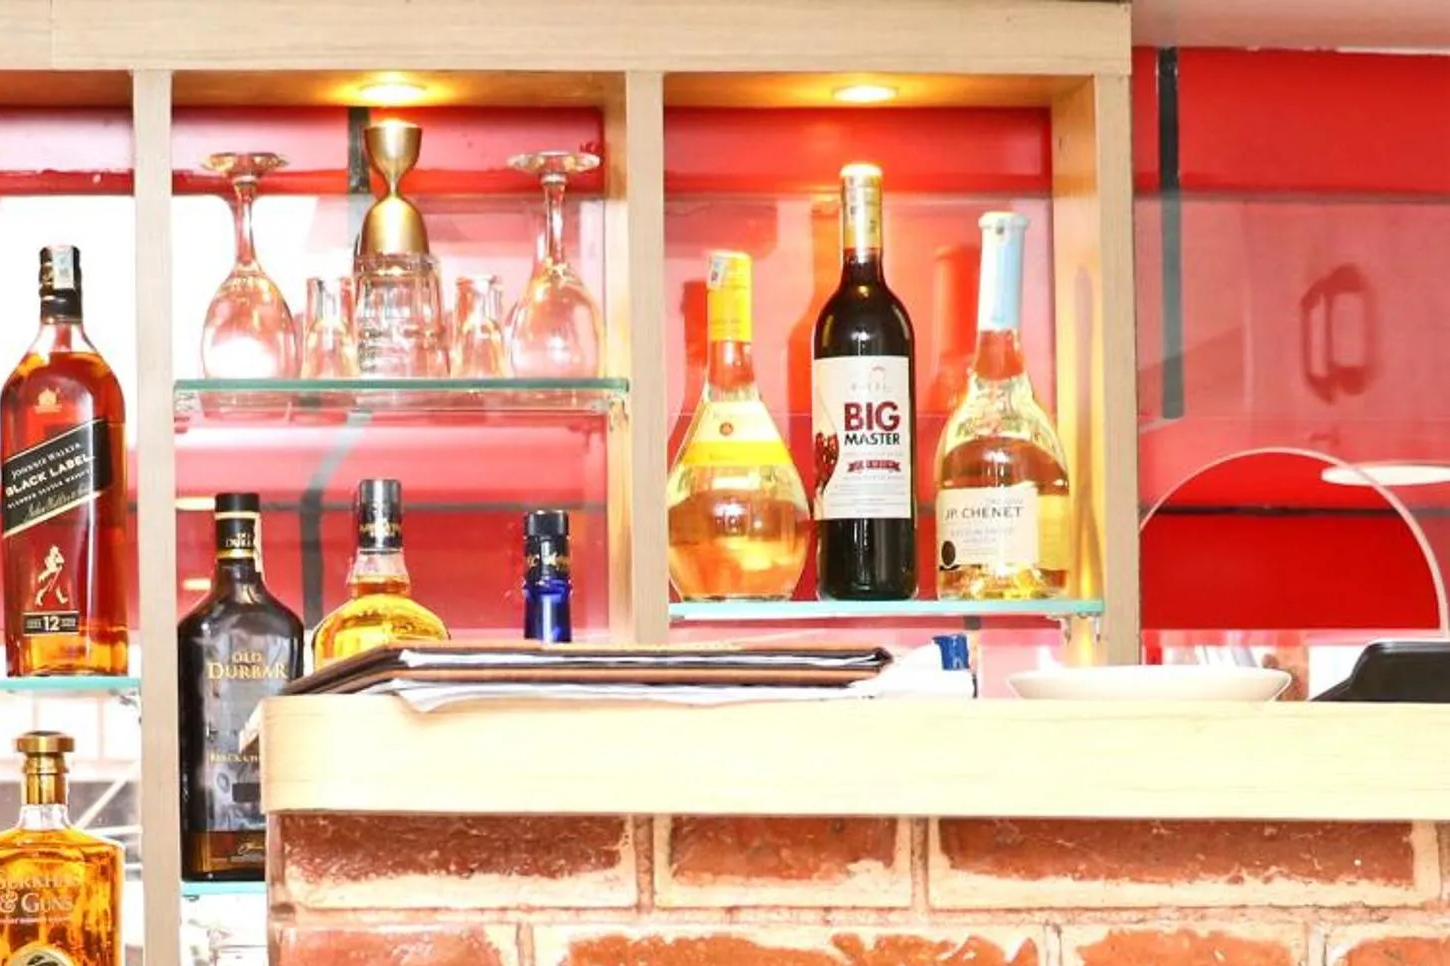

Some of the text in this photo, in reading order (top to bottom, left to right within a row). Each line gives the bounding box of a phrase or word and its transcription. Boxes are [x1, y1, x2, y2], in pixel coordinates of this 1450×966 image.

[844, 401, 900, 432] BIG
[844, 432, 900, 445] MASTER
[6, 453, 95, 497] BLACK LABEL
[962, 506, 1024, 519] CHENET
[43, 615, 60, 631] 12
[232, 651, 263, 662] OLD
[206, 661, 288, 680] DURBAR
